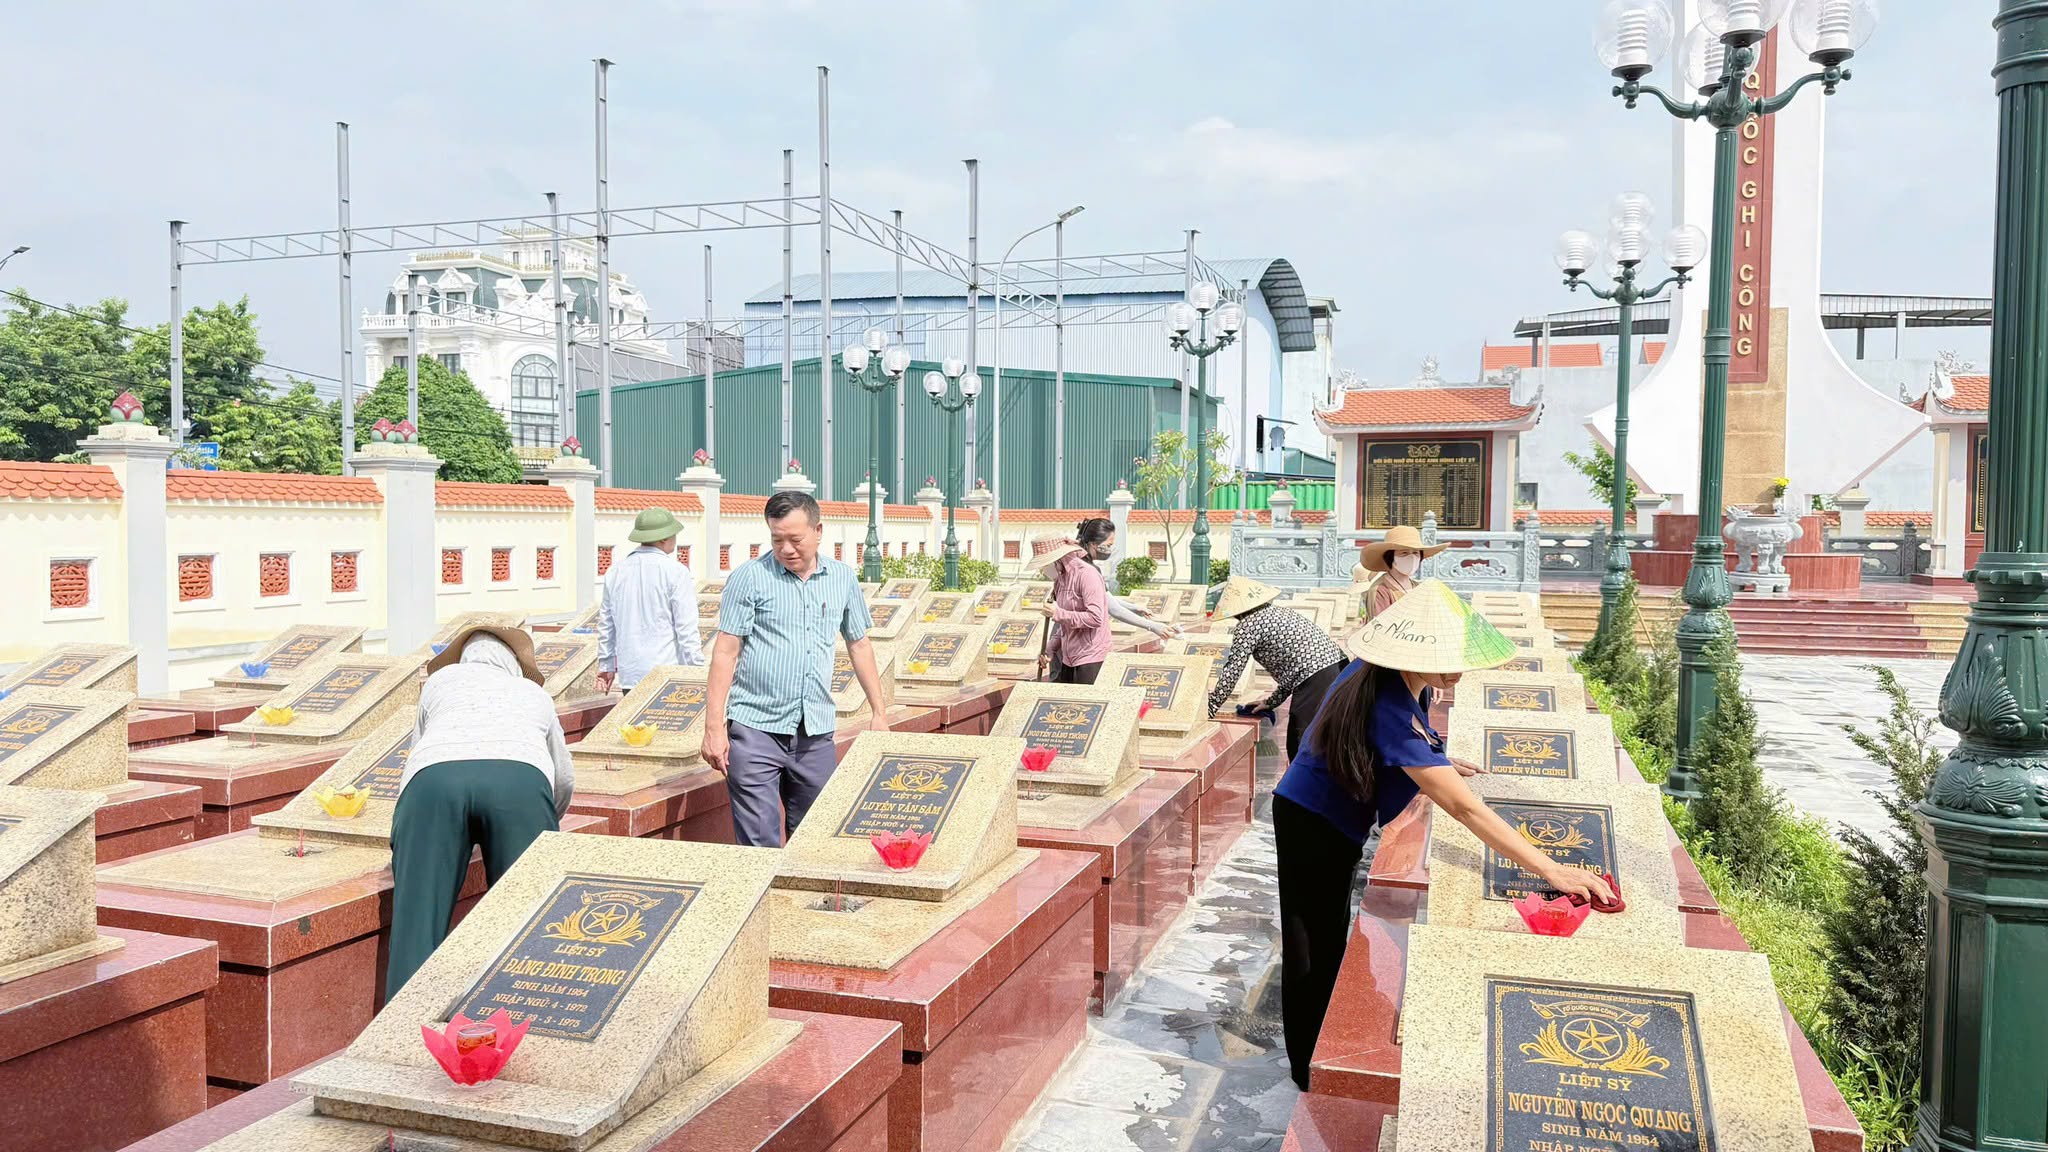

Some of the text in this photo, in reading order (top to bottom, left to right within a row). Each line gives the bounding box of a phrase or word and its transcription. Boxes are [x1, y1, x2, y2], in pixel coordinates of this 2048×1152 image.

[1741, 180, 1758, 250] GHI
[1736, 263, 1755, 357] CÔNG
[553, 941, 586, 957] LIỆT
[502, 955, 627, 987] ĐẶNG ĐÌNH TRỌNG
[512, 980, 591, 997] SINH NĂM 1954
[493, 991, 524, 1005] NHẬP
[551, 1001, 559, 1009] 4
[564, 1002, 589, 1013] 1972
[477, 1006, 497, 1016] HY
[557, 1018, 582, 1028] 1975
[1558, 1072, 1633, 1092] LIỆT SỸ
[1507, 1087, 1692, 1133] NGUYỄN NGỌC QUANG
[1541, 1122, 1582, 1138] SINH
[1585, 1126, 1623, 1144] NĂM
[1627, 1133, 1660, 1148] 1954
